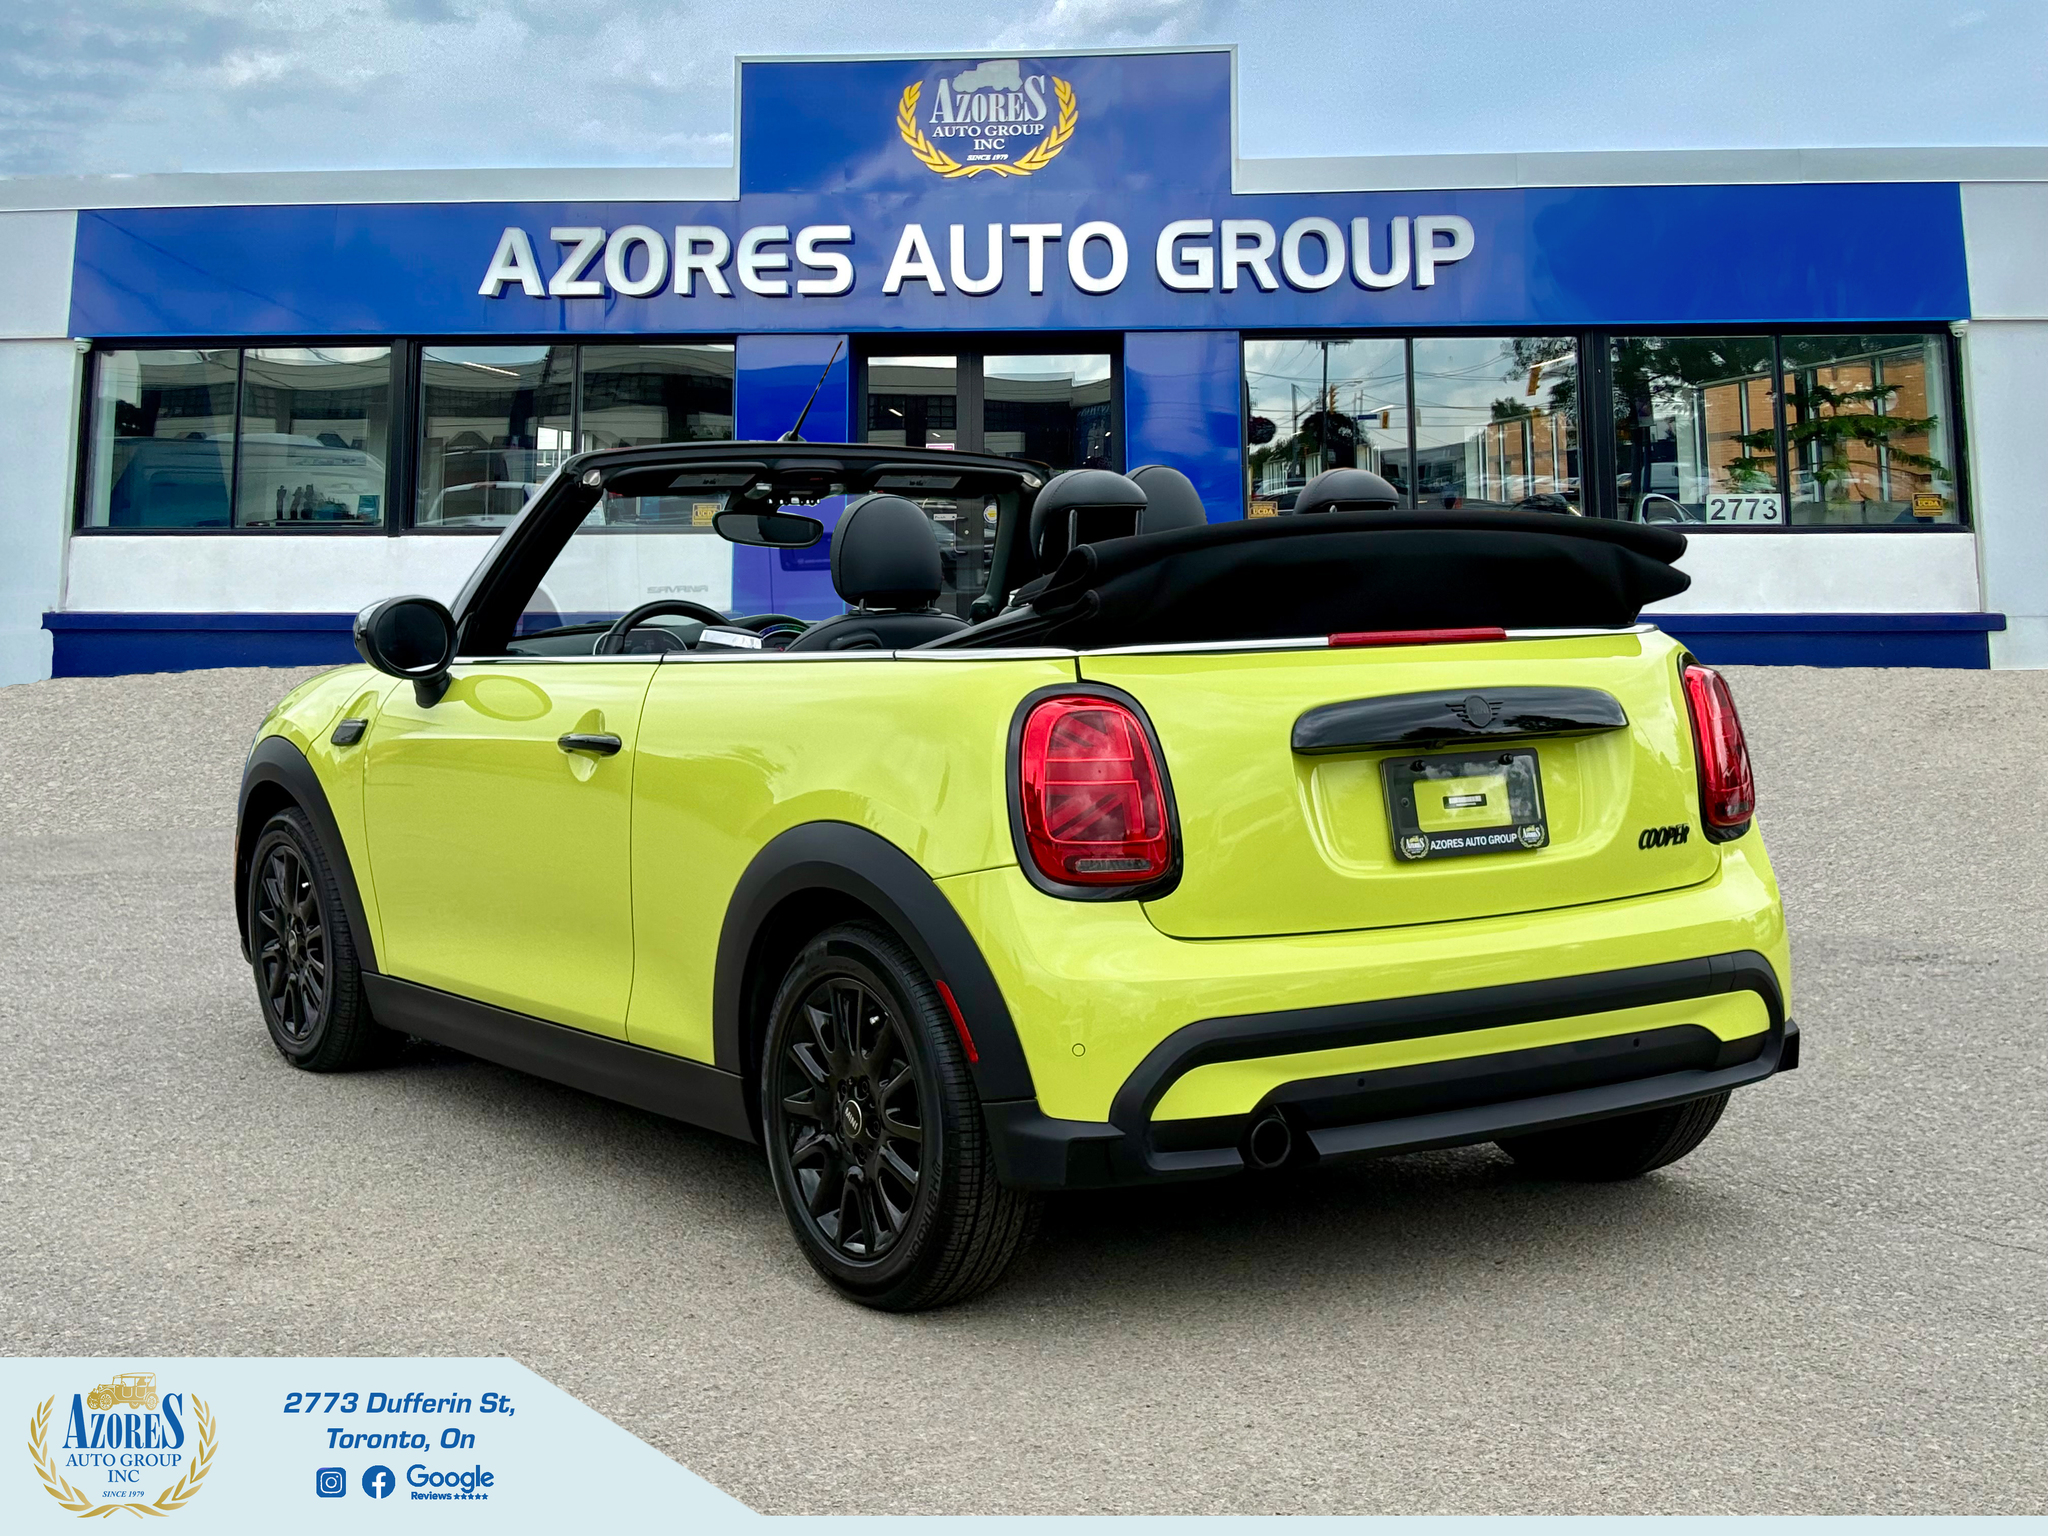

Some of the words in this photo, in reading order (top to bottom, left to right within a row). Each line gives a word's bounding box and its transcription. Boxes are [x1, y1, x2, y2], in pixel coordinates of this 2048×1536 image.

[929, 75, 1047, 124] AZORES
[933, 125, 982, 138] AUTO
[985, 124, 1044, 136] GROUP
[974, 139, 1005, 150] INC
[478, 224, 855, 298] AZORES
[881, 220, 1129, 296] AUTO
[1156, 215, 1476, 293] GROUP
[1710, 498, 1778, 521] 2773
[1430, 837, 1464, 850] AZORES
[1465, 835, 1487, 847] AUTO
[1488, 832, 1517, 845] GROUP
[1638, 823, 1690, 850] COOPER
[845, 1107, 858, 1129] MINI
